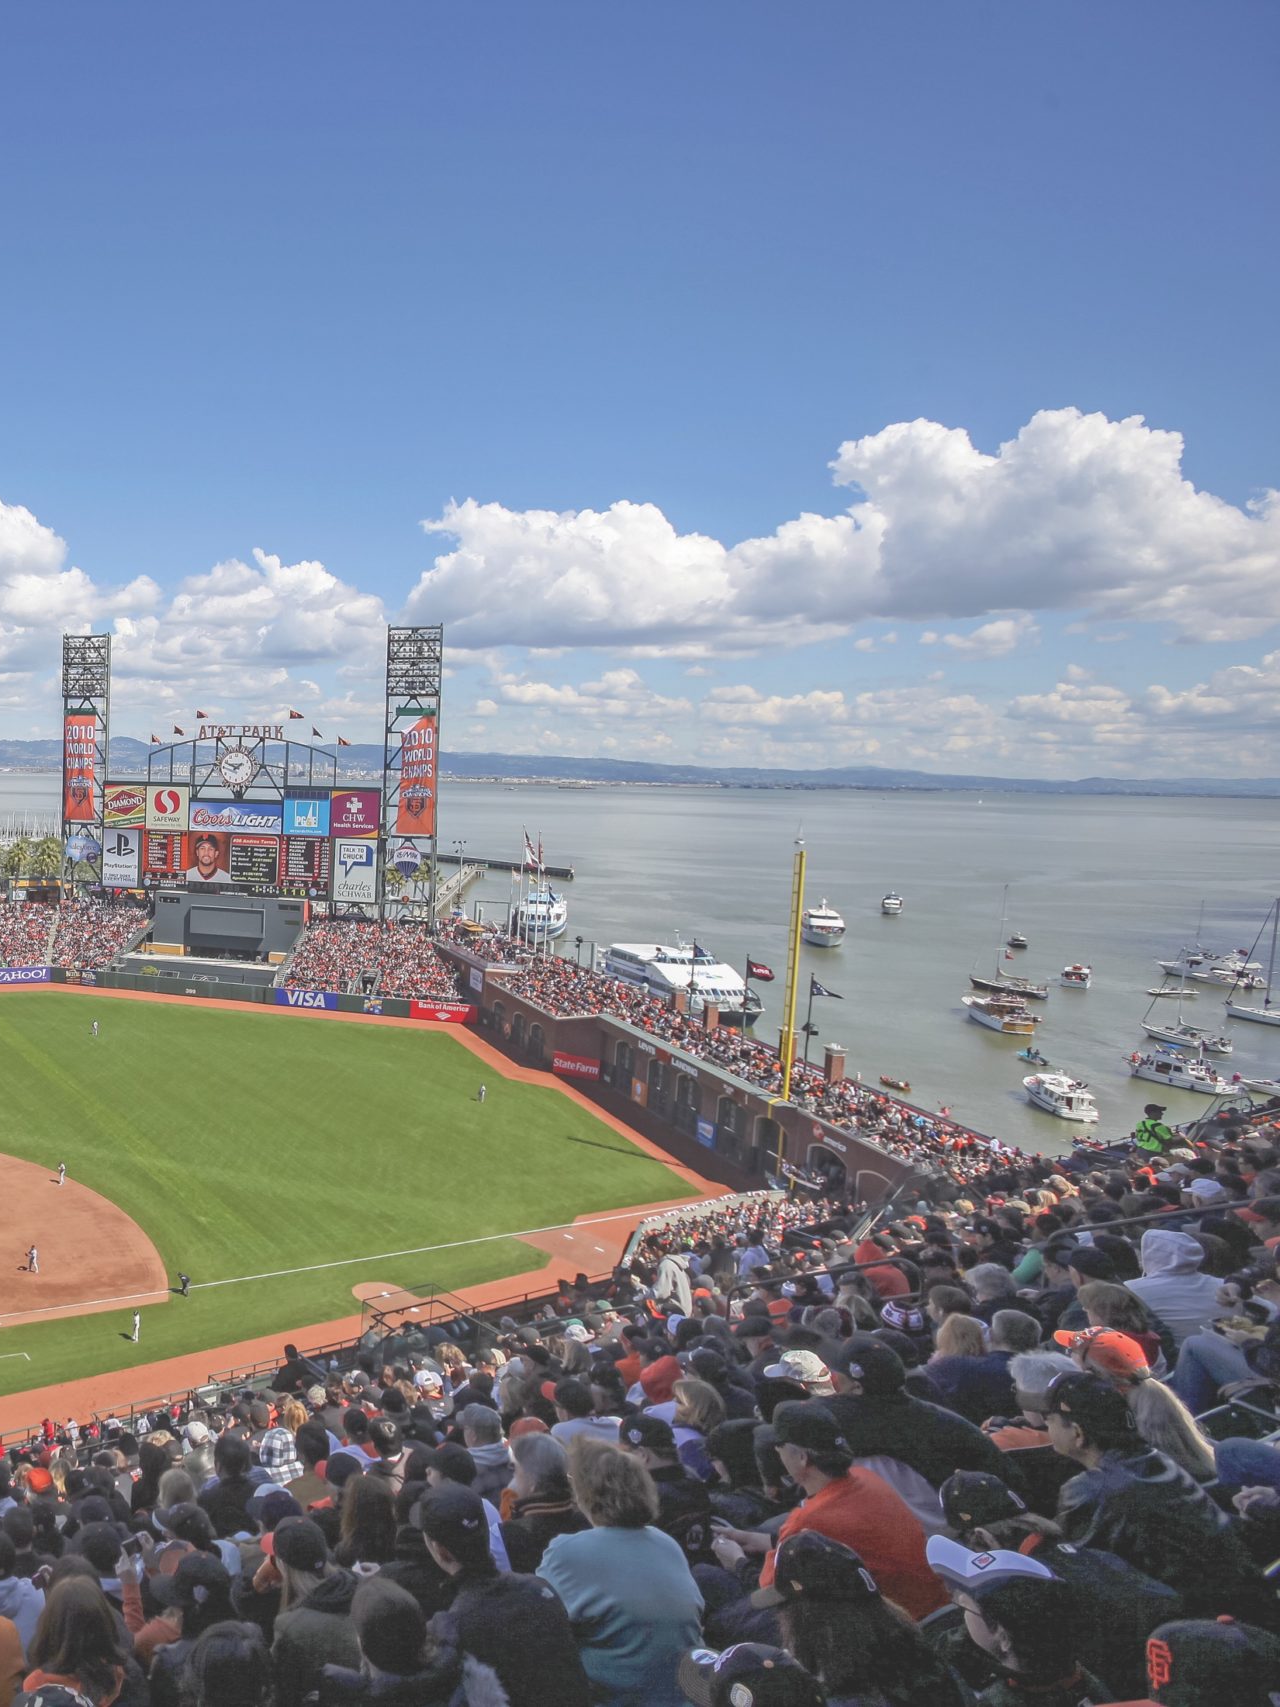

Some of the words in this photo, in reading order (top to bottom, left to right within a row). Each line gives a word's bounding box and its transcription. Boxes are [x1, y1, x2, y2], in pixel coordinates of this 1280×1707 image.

[67, 725, 94, 740] 2010
[199, 725, 235, 739] AT&T
[242, 725, 284, 739] PARK
[404, 728, 433, 747] 2010
[66, 743, 94, 755] WORLD
[404, 748, 433, 763] WORLD
[66, 757, 93, 770] CHAMPS
[403, 764, 433, 778] CHAMPS
[108, 797, 143, 810] DIAMOND
[193, 808, 233, 826] Coors
[232, 815, 279, 828] LIGHT
[295, 815, 318, 827] PG&E
[342, 813, 365, 822] CHW
[396, 850, 418, 858] RE/MAX
[282, 887, 287, 896] 1
[291, 888, 296, 896] 1
[300, 889, 306, 897] 0
[338, 880, 371, 891] charles
[337, 891, 372, 899] SCHWAB
[285, 990, 326, 1008] VISA
[418, 1001, 434, 1009] Bank
[435, 1002, 443, 1010] of
[443, 1003, 470, 1012] America
[553, 1057, 576, 1071] State
[575, 1063, 599, 1076] Farm
[671, 1057, 698, 1078] LANDING
[1145, 1638, 1173, 1690] SF
